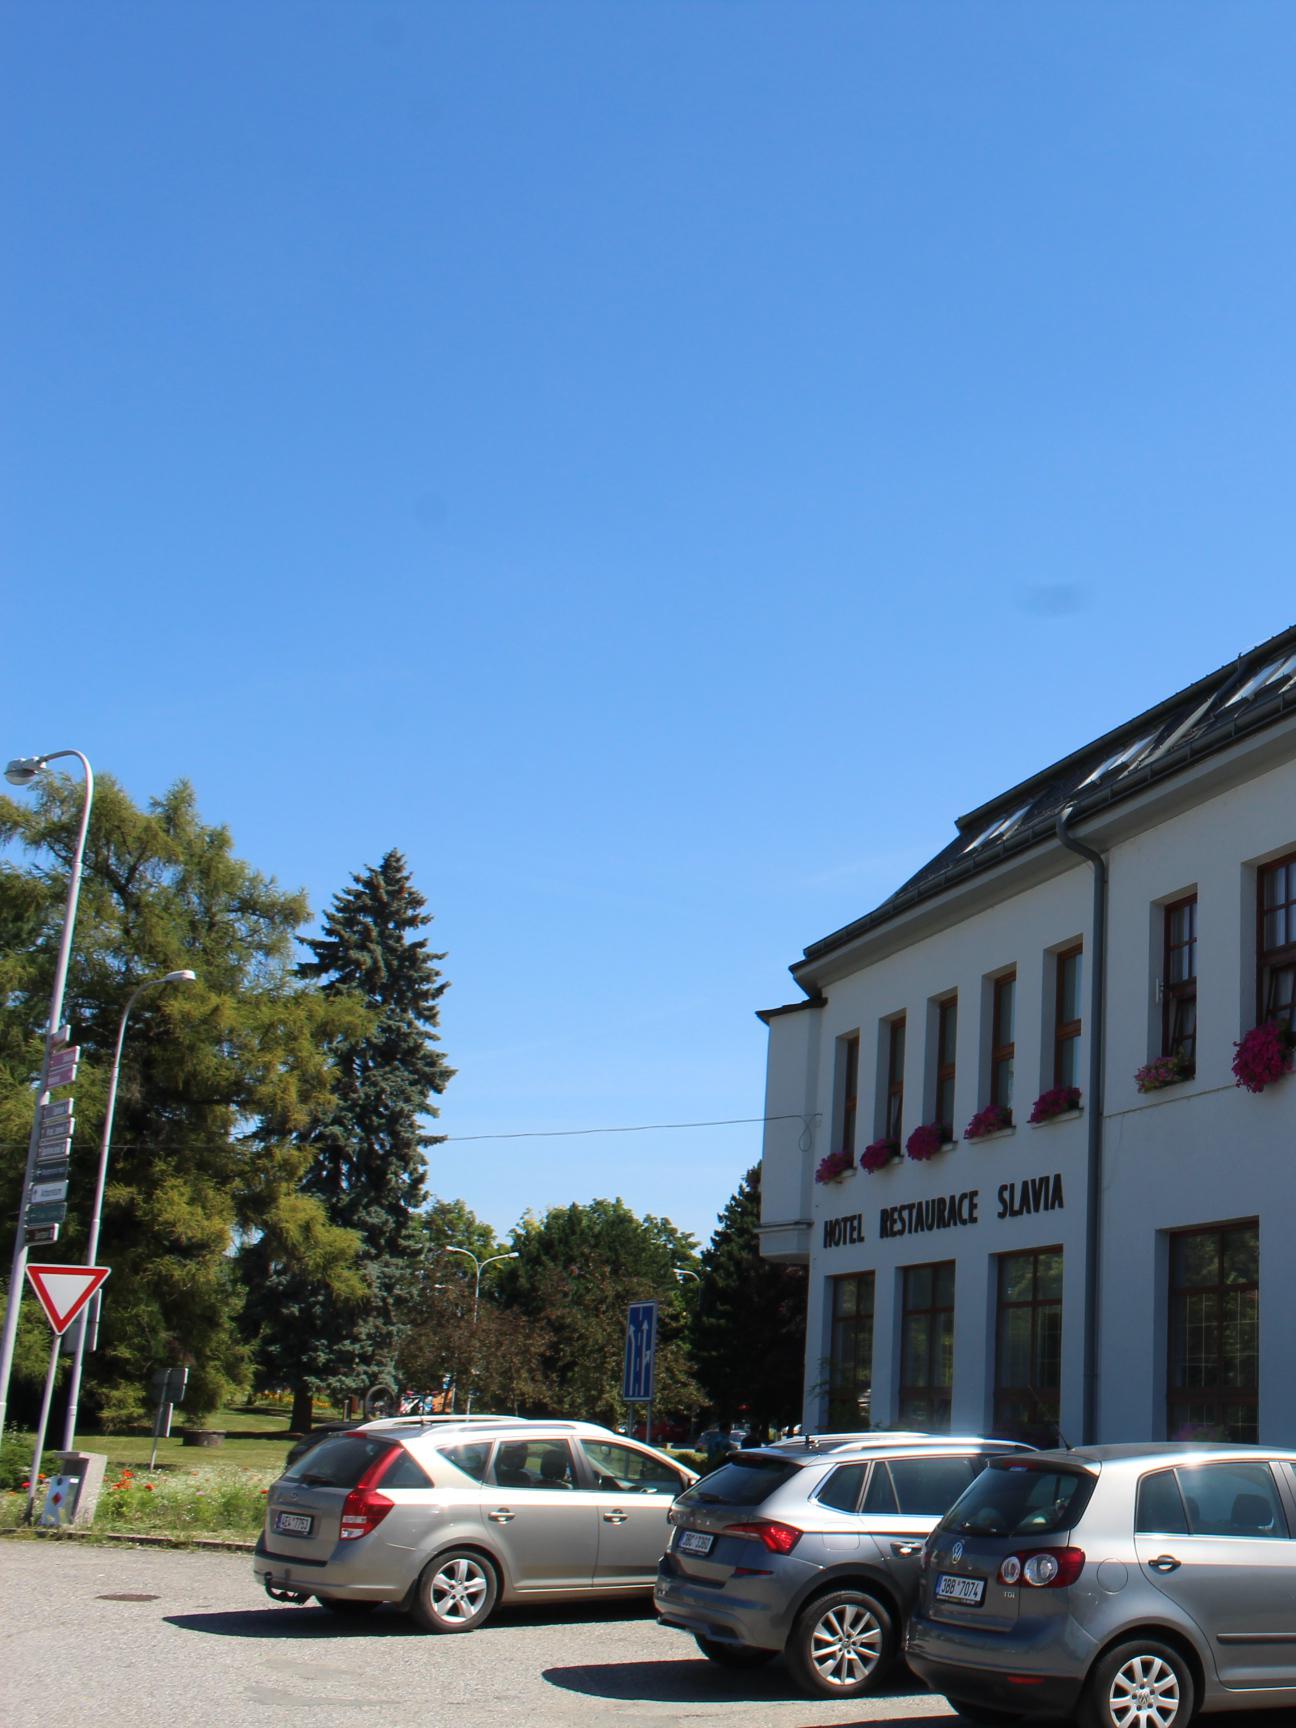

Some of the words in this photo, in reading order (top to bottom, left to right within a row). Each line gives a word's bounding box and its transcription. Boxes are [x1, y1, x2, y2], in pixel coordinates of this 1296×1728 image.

[823, 1213, 865, 1249] HOTEL
[879, 1190, 979, 1239] RESTAURACE
[997, 1173, 1065, 1219] SLAVIA
[941, 1578, 957, 1595] 3BB
[960, 1580, 980, 1598] 7074
